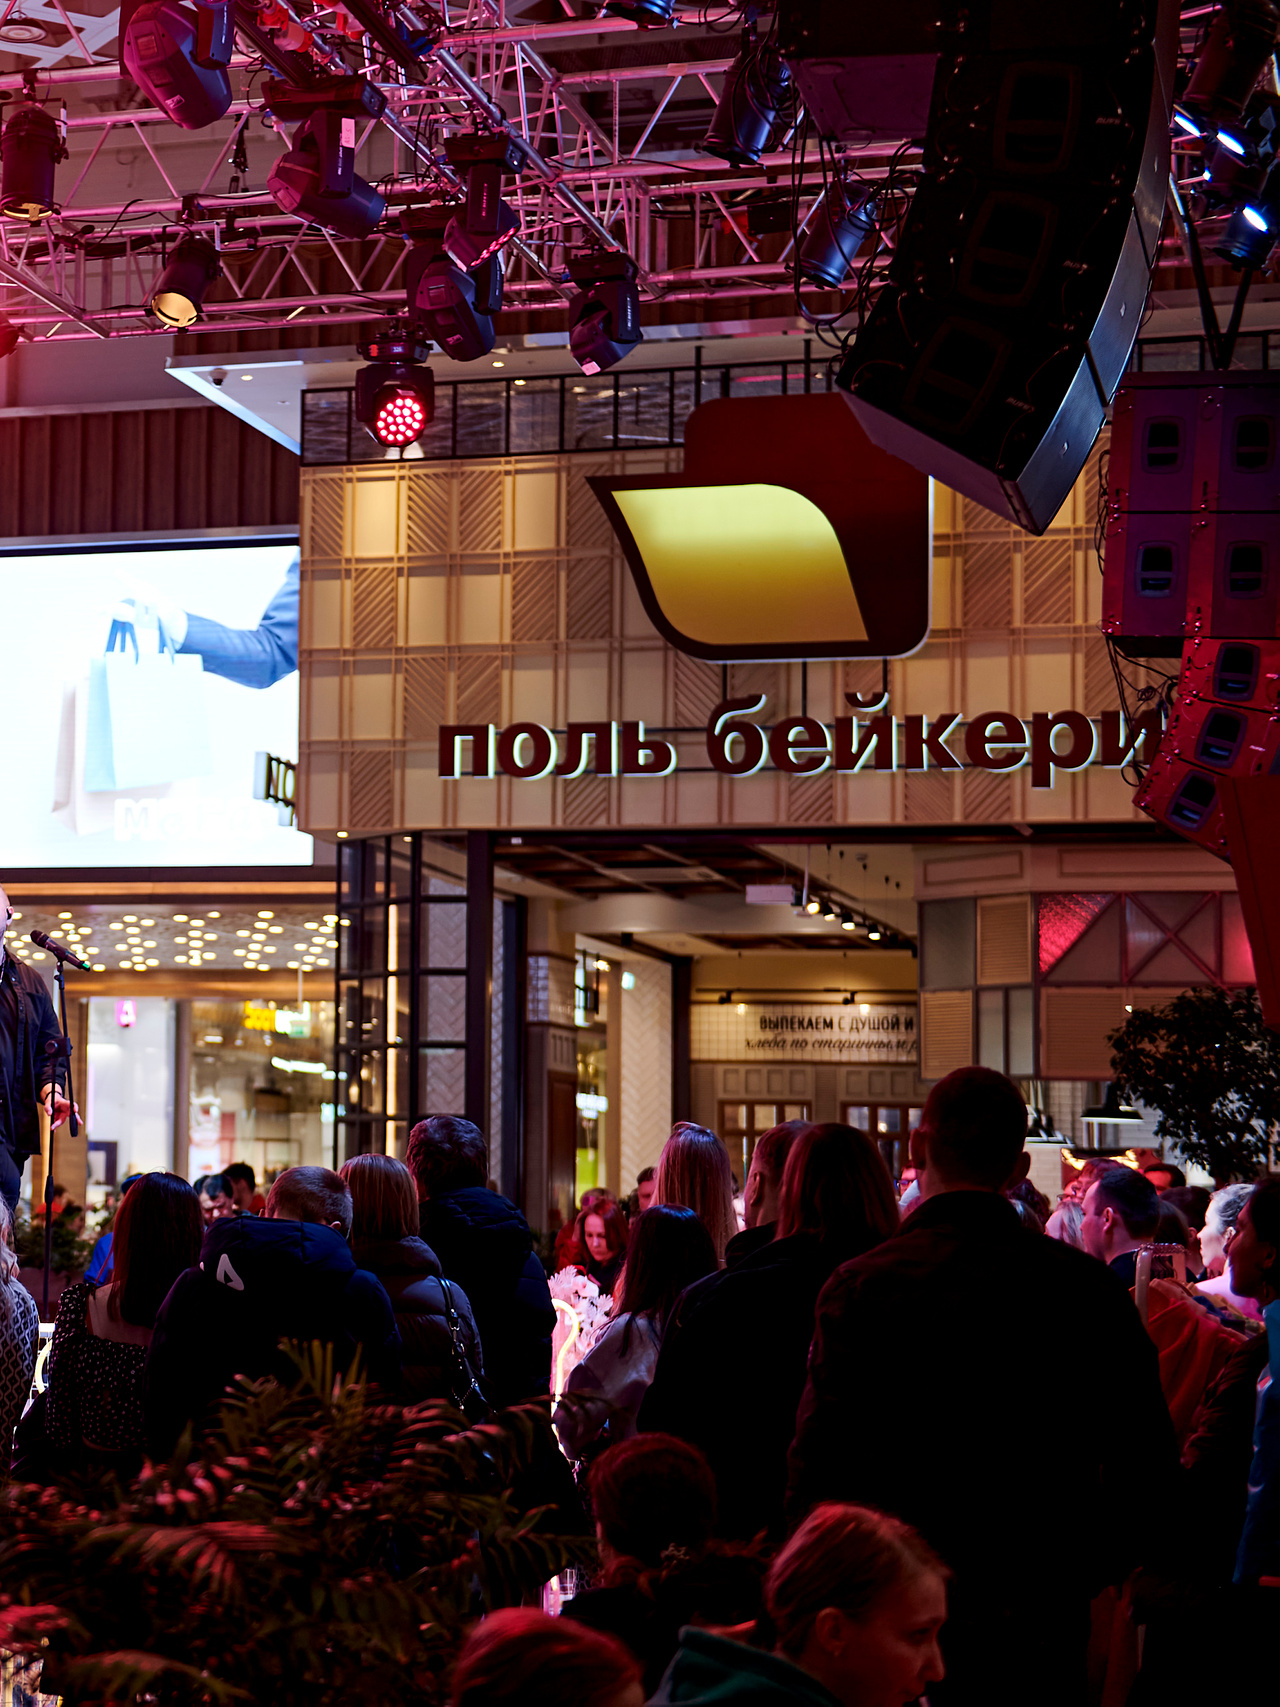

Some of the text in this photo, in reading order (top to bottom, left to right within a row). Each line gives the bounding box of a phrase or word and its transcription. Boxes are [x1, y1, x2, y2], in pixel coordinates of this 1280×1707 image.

[437, 691, 1167, 790] поль бейкери
[759, 1012, 914, 1033] ВЫПЕКАЕМ С ДУШОЙ И
[745, 1032, 787, 1049] хлеба
[790, 1037, 808, 1049] по
